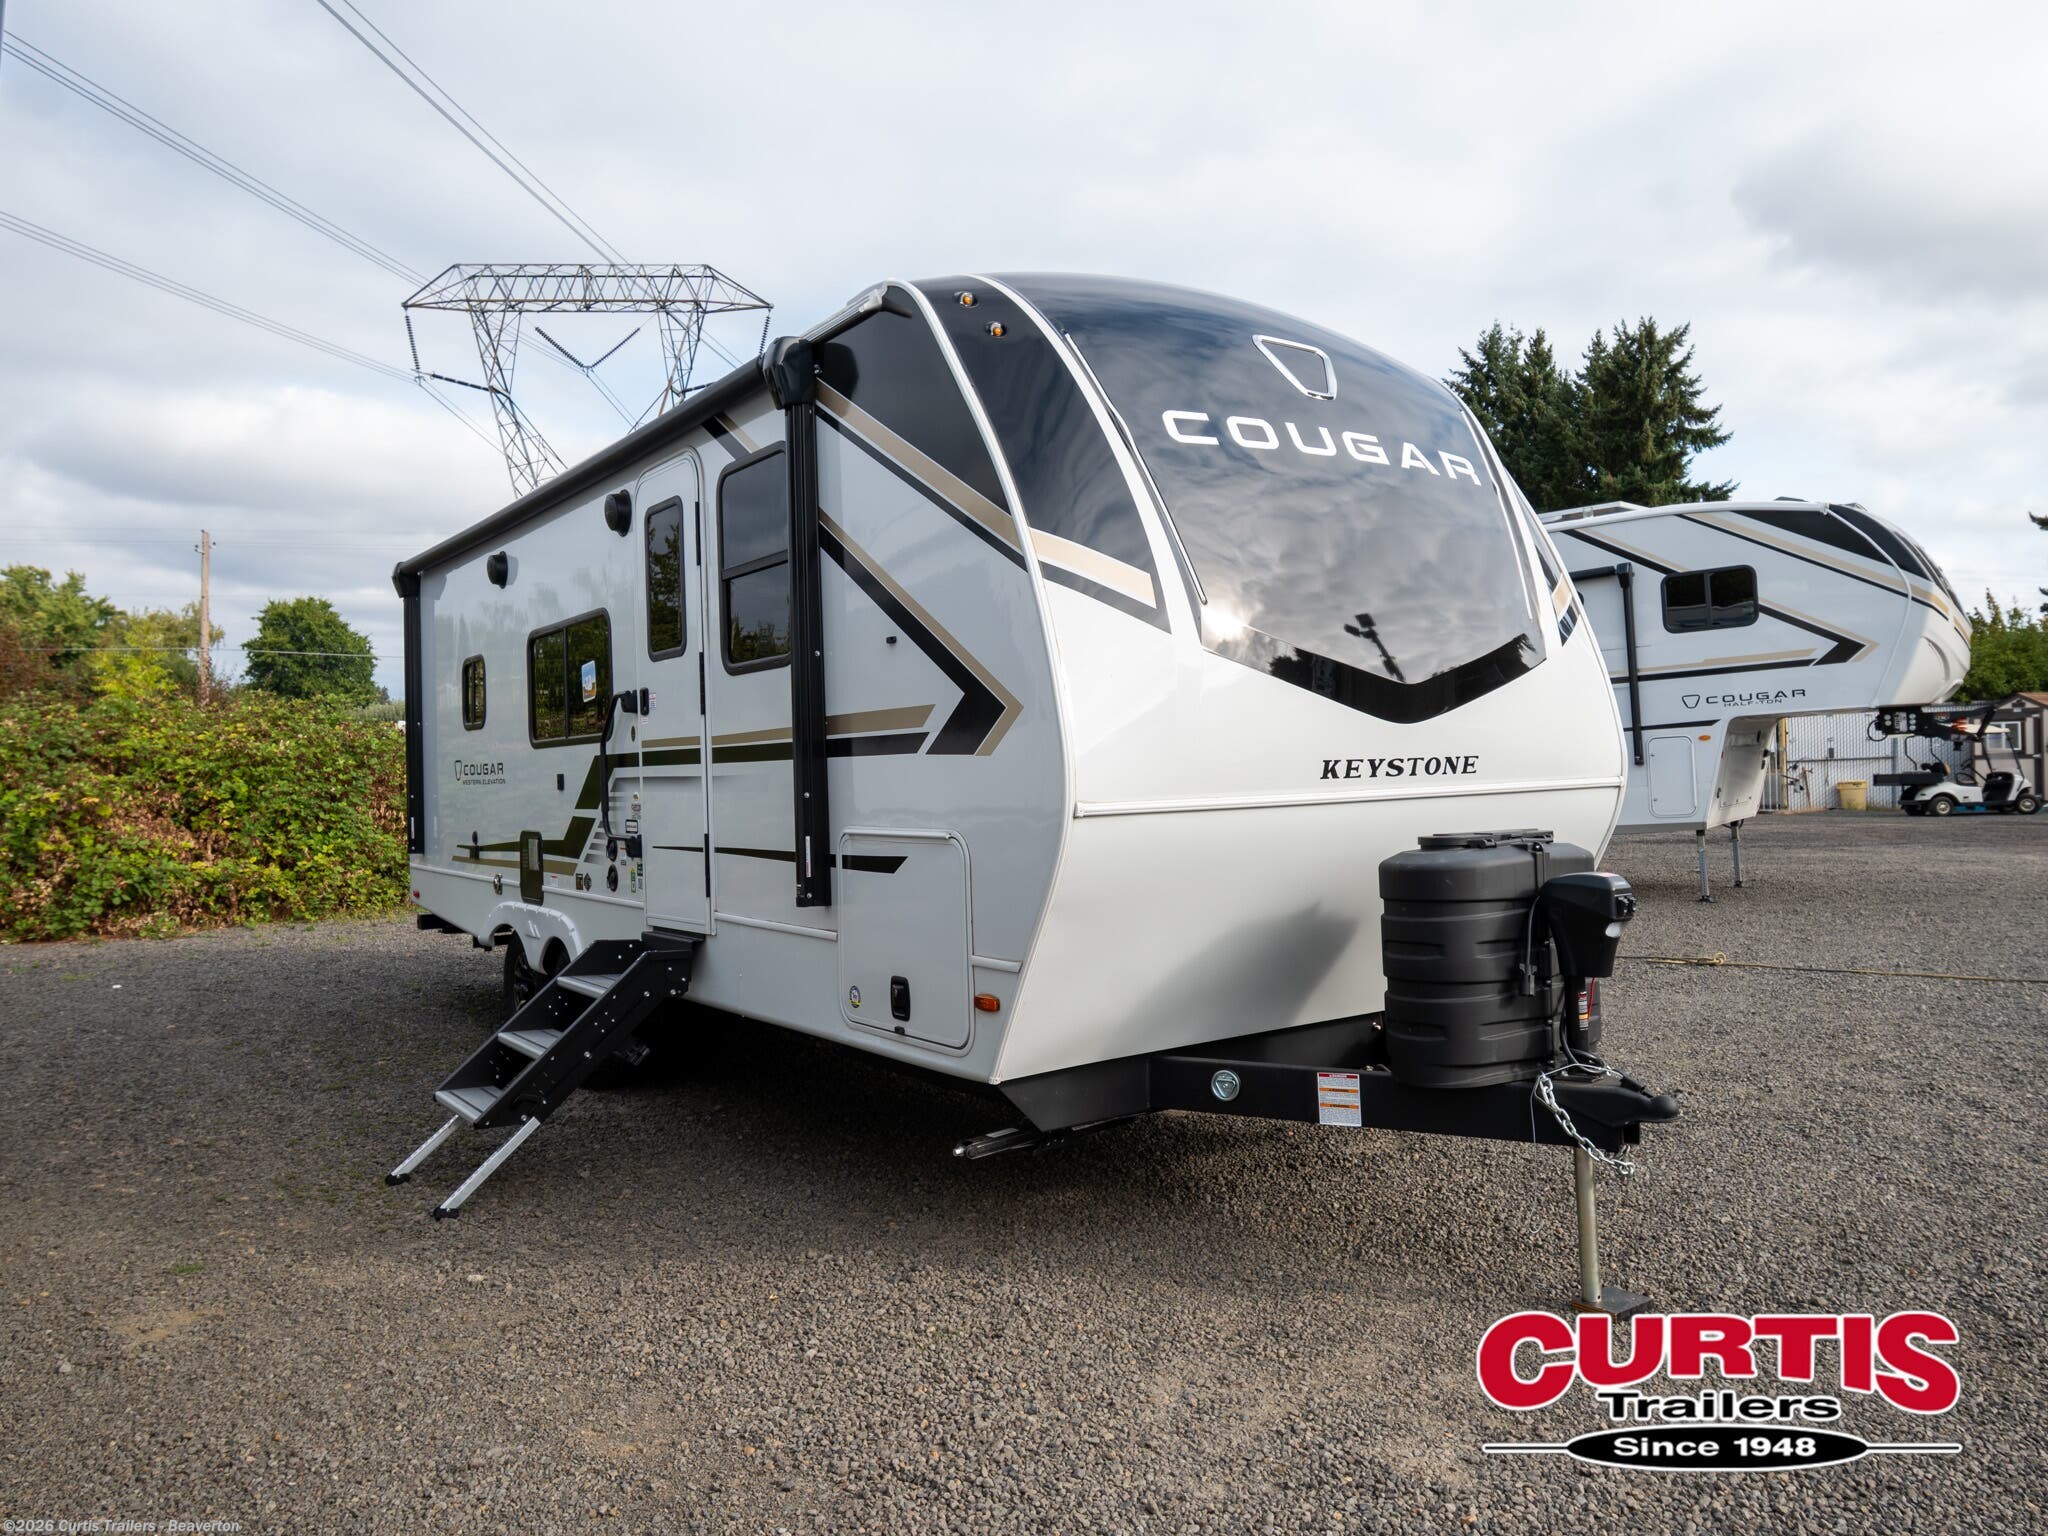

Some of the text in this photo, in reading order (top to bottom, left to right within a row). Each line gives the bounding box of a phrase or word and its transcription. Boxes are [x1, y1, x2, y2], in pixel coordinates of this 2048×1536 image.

[1162, 409, 1482, 486] COUGAR
[1705, 689, 1806, 704] COUGAR
[1723, 699, 1783, 708] HALF-TON
[463, 762, 504, 776] COUGAR
[1320, 755, 1480, 780] KEYSTONE
